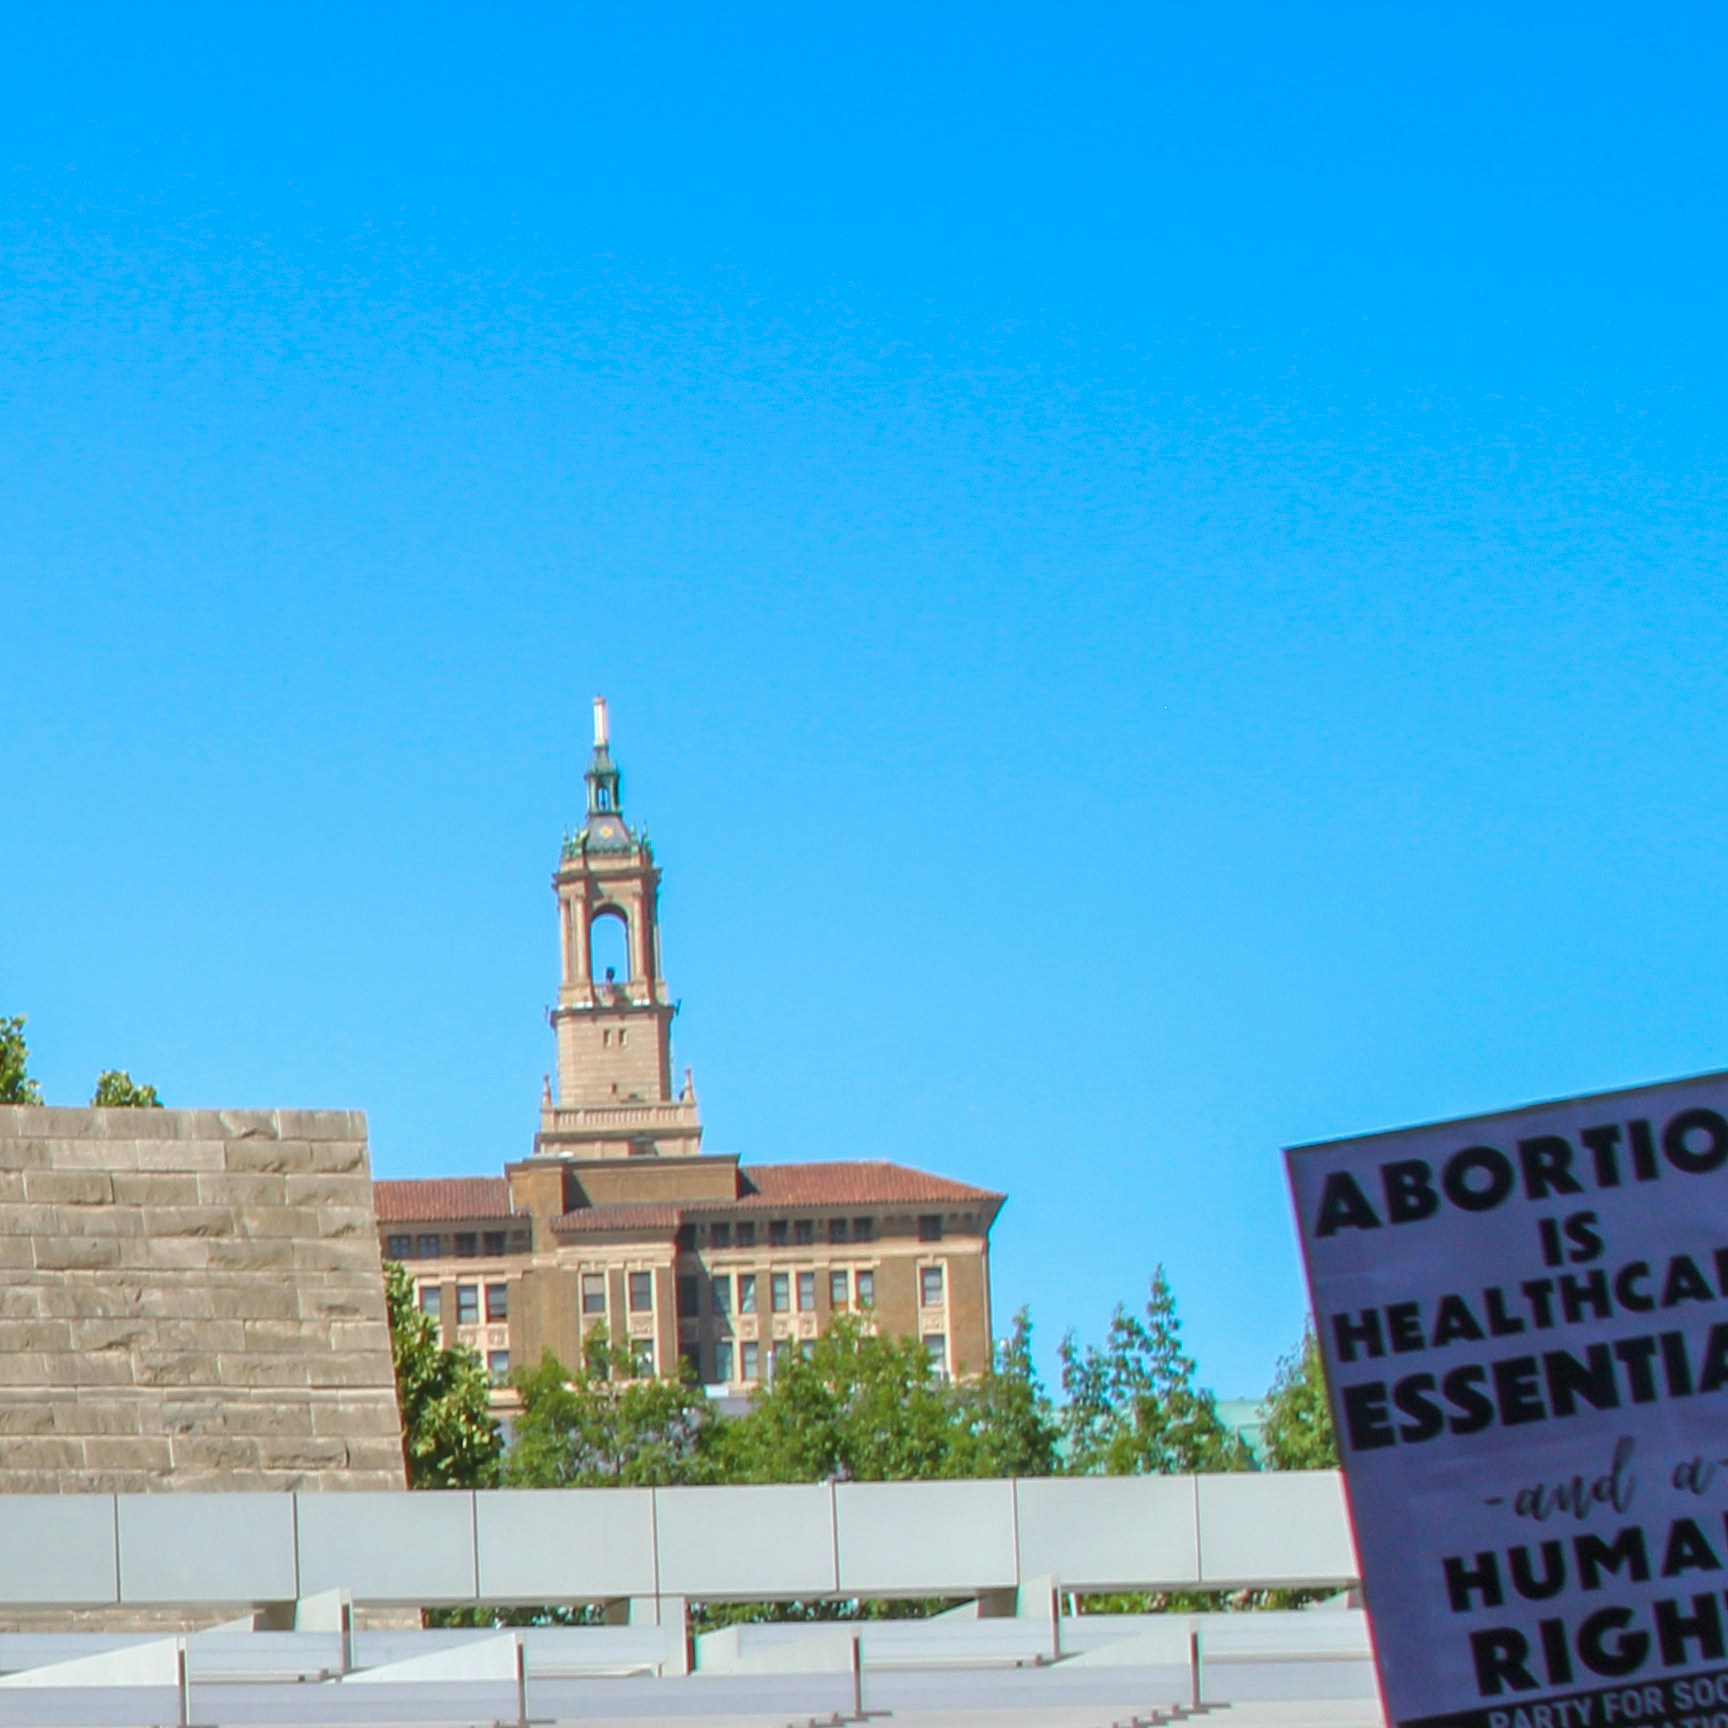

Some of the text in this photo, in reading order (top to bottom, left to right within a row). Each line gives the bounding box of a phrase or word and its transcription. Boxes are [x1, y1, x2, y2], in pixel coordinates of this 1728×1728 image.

[1314, 1107, 1728, 1238] ABORTIO
[1538, 1211, 1605, 1267] IS
[1332, 1249, 1728, 1364] HEALTHCA
[1441, 1508, 1728, 1612] HUMA
[1602, 1685, 1665, 1722] FOR
